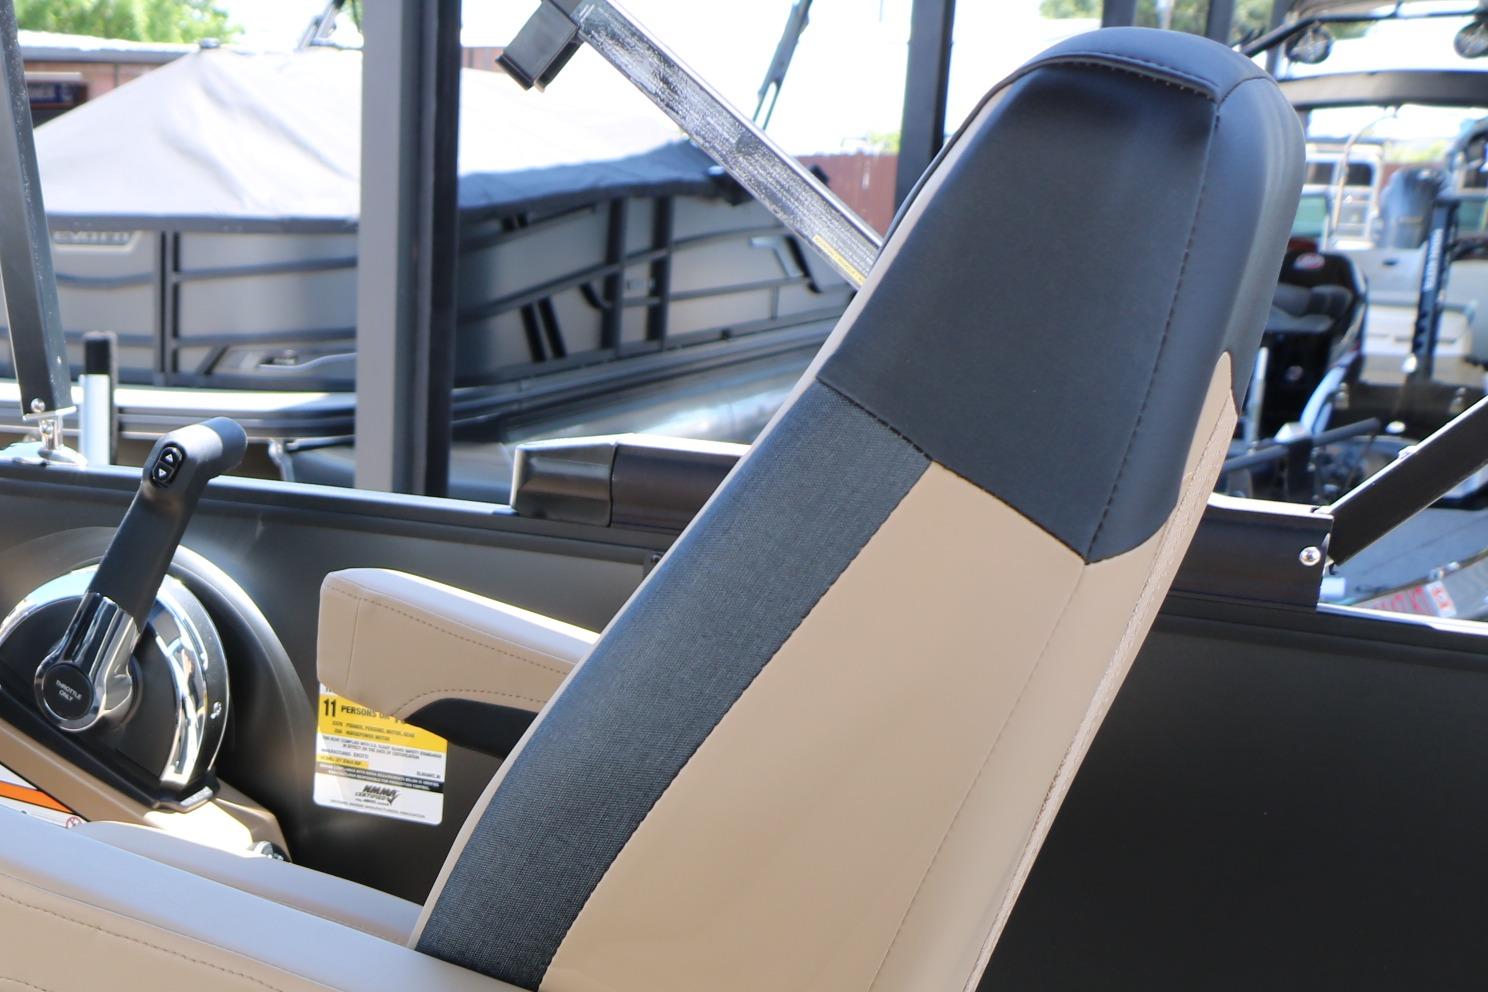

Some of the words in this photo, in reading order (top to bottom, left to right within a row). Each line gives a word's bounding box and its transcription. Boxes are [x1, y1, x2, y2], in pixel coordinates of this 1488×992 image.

[55, 680, 82, 700] THROTTLE
[59, 690, 73, 701] ONLY
[323, 698, 337, 717] 11
